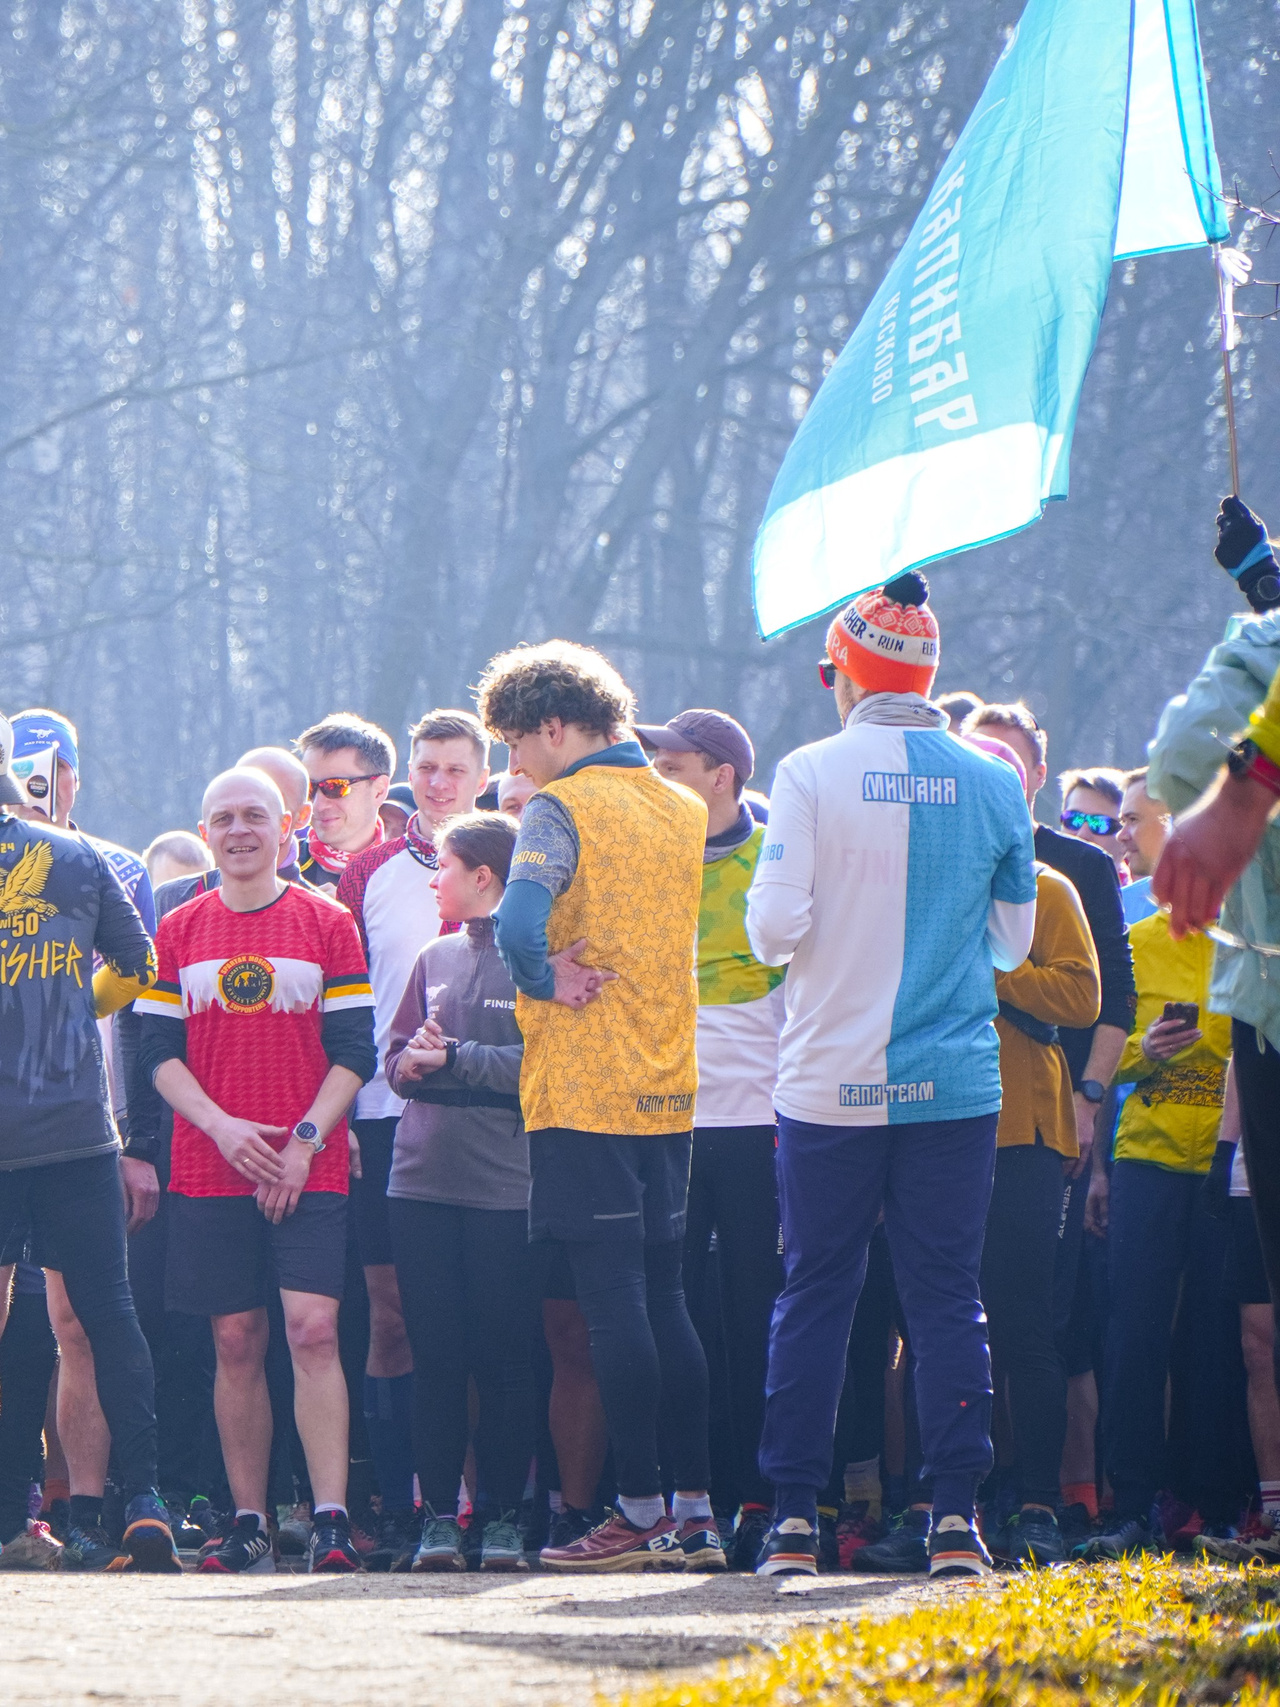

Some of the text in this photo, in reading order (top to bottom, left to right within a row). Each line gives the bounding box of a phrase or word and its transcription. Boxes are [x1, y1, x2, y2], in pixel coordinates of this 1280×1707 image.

[872, 290, 901, 404] КУСКОВО
[877, 634, 905, 653] RUN
[863, 772, 957, 805] МИШАНЯ
[12, 912, 39, 938] 50
[220, 955, 274, 976] SPARTAK MOSCOW
[483, 999, 516, 1010] FINIS
